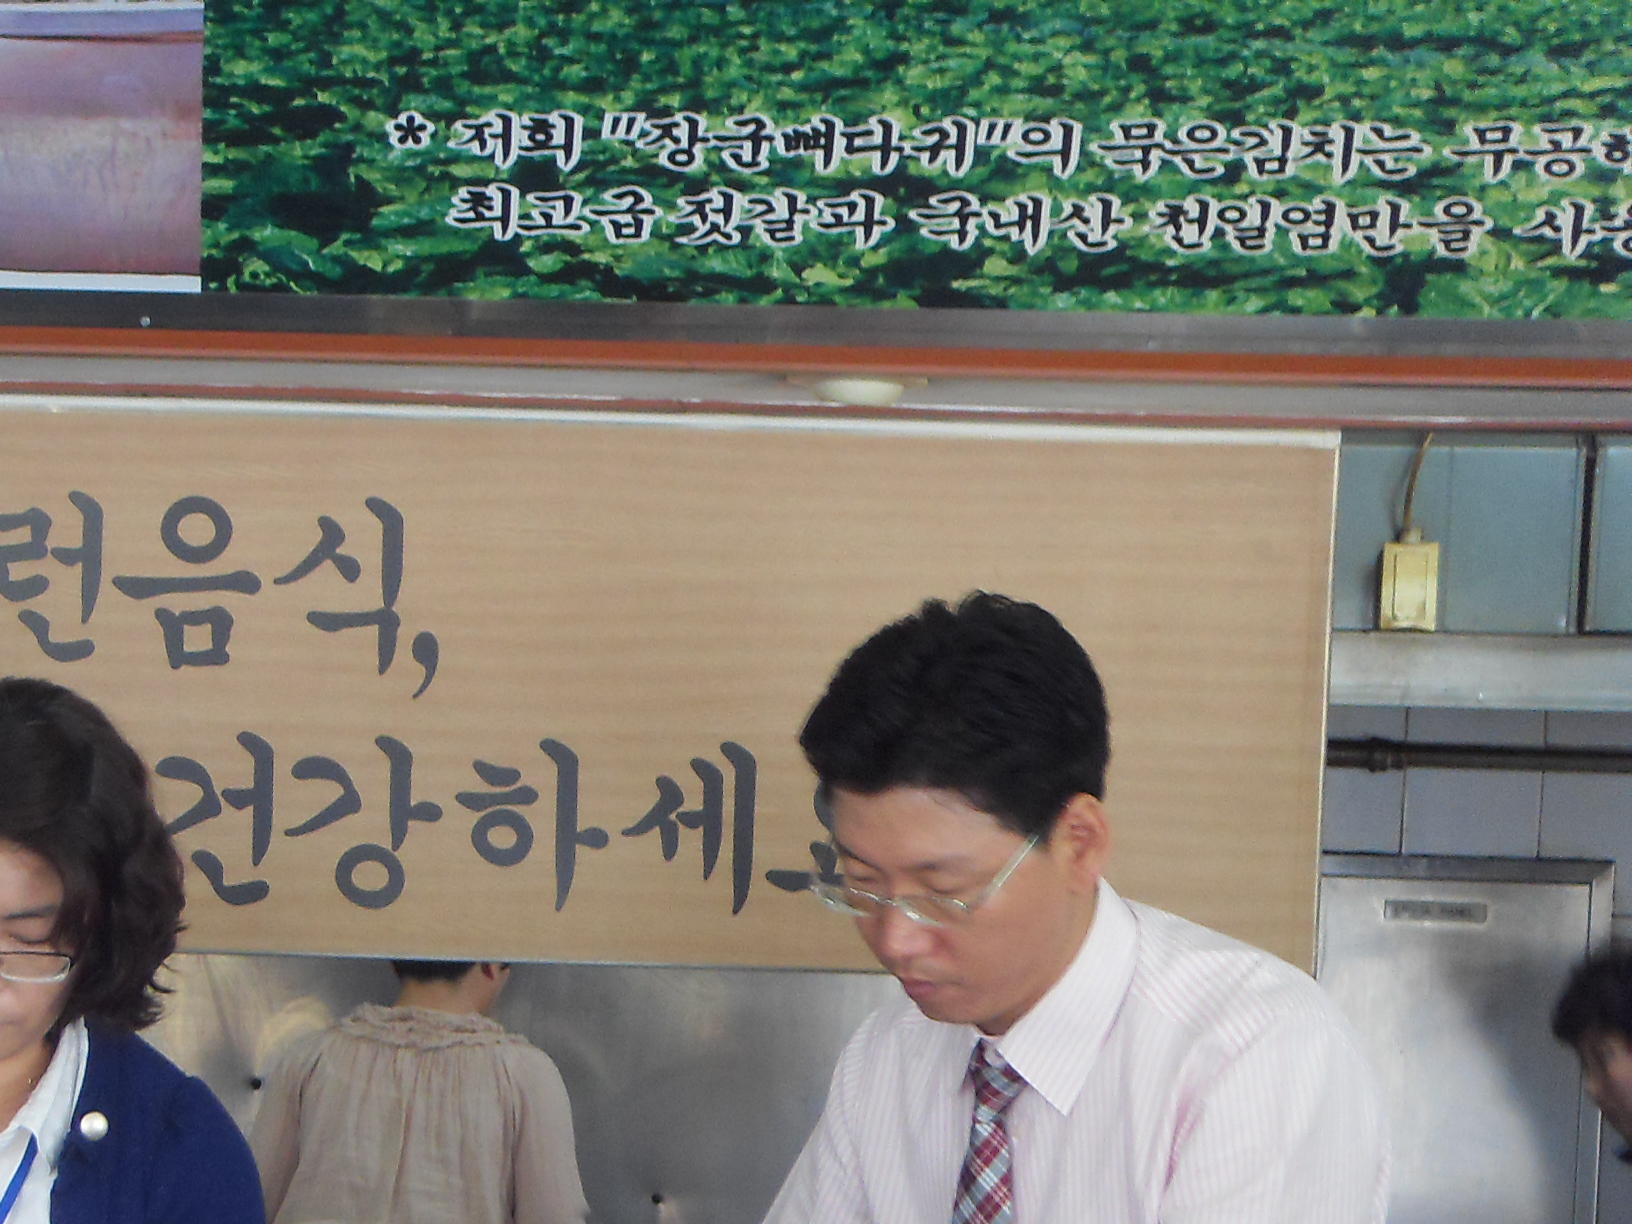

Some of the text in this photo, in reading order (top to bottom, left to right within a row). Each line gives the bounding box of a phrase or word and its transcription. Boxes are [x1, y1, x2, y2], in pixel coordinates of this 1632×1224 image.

[453, 112, 576, 168] 저희
[450, 185, 657, 240] 최고급
[914, 192, 1127, 250] 국내산
[1153, 198, 1486, 254] 천일염만을
